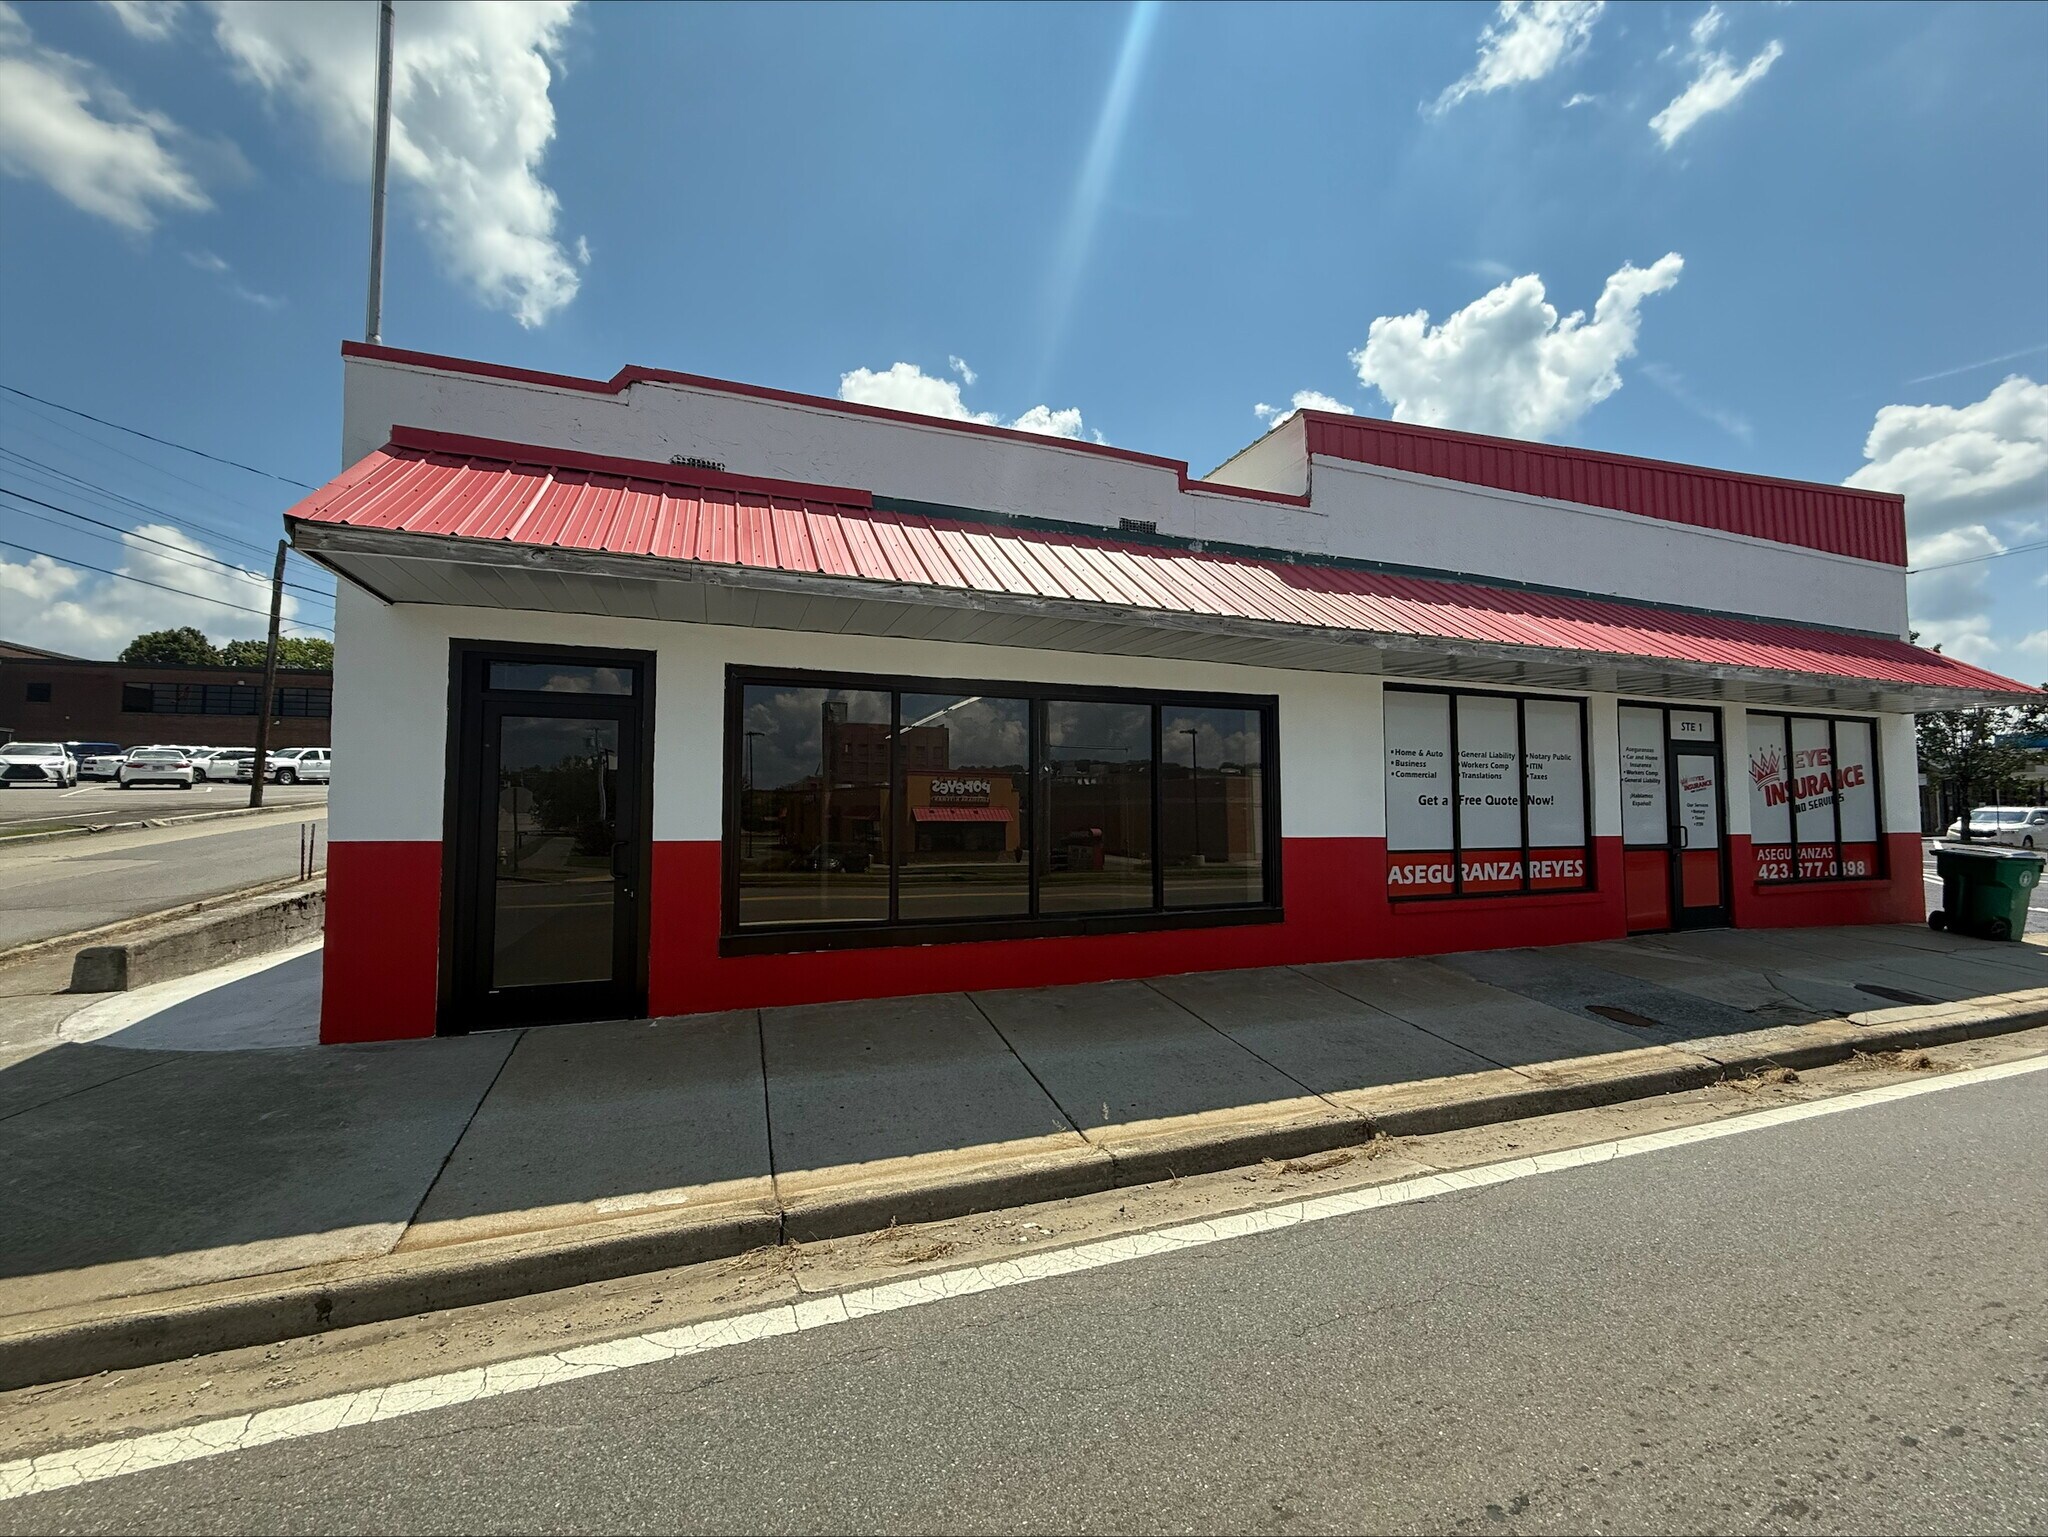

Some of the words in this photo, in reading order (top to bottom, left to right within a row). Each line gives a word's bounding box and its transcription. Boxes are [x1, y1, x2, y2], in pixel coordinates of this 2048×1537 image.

[1681, 722, 1696, 732] STE
[1394, 749, 1416, 757] Home
[1426, 750, 1443, 758] Auto
[1461, 751, 1487, 759] General
[1489, 752, 1516, 761] Liability
[1529, 753, 1551, 761] Notary
[1395, 760, 1426, 768] Business
[1490, 762, 1509, 771] Comp
[1395, 770, 1437, 779] Commercial
[1461, 772, 1502, 780] Translations
[1418, 795, 1438, 806] Get
[1442, 798, 1448, 806] a
[1459, 795, 1482, 806] Free
[1485, 795, 1518, 806] Quote
[1527, 795, 1554, 806] Now!
[1388, 861, 1523, 884] ASEGURANZA
[1529, 860, 1584, 878] REYES
